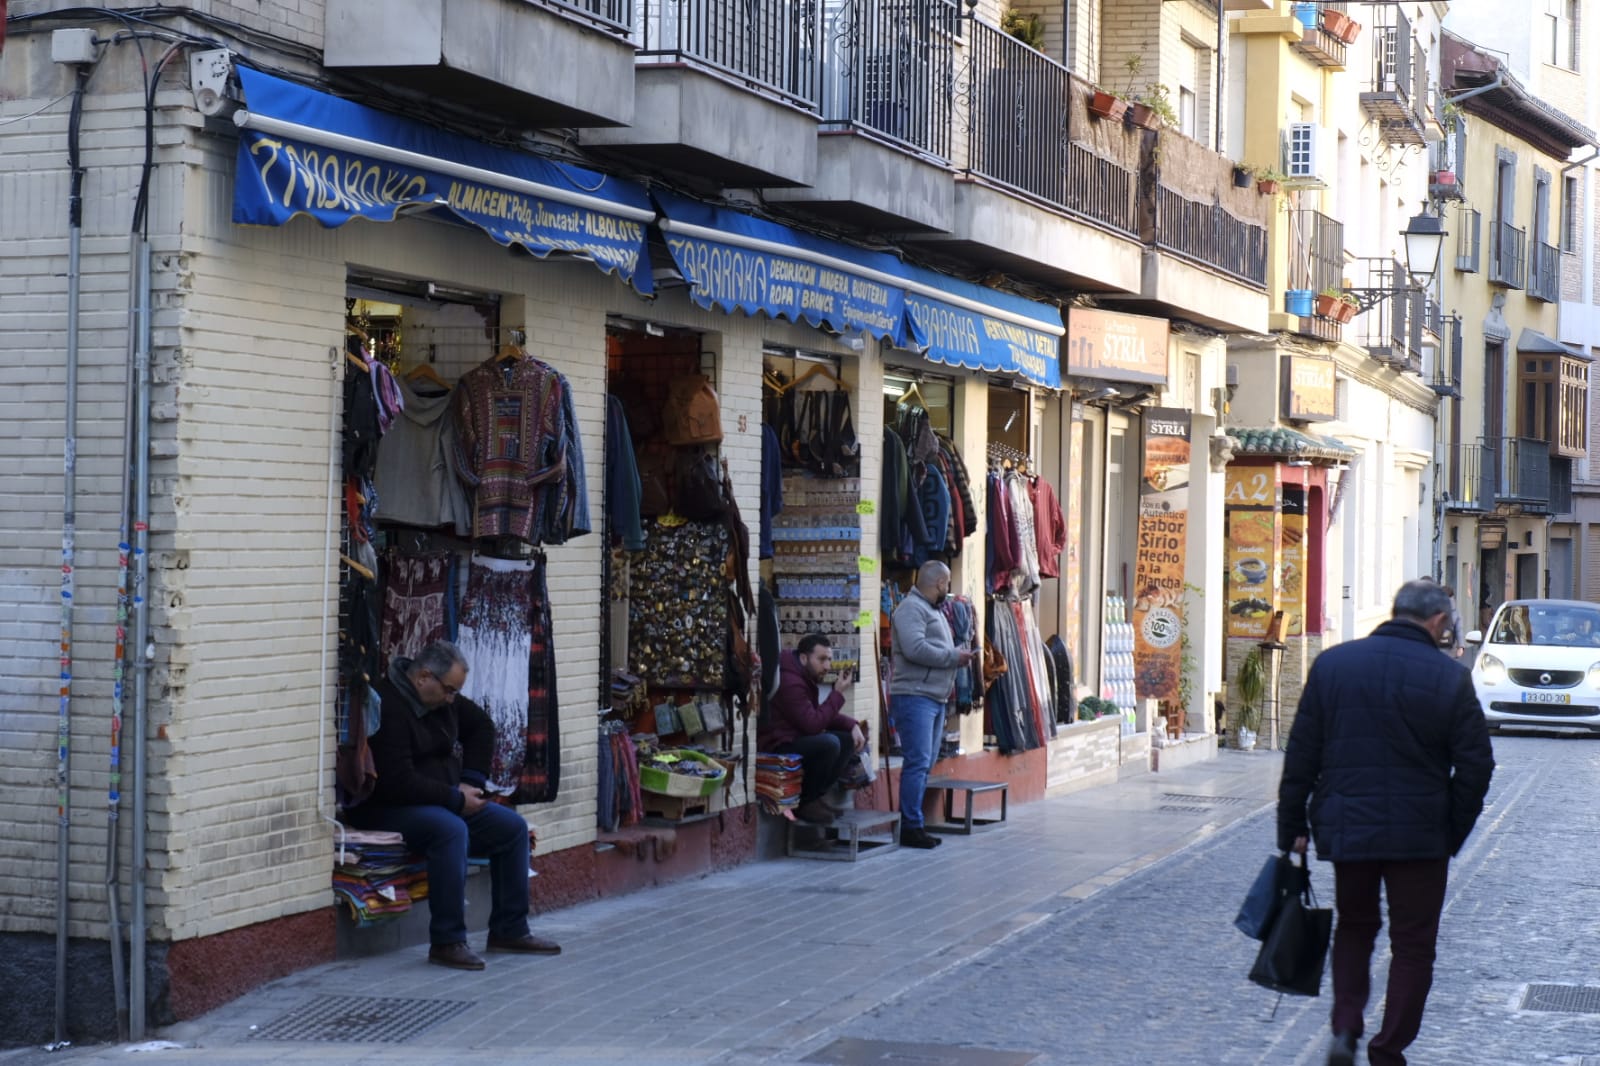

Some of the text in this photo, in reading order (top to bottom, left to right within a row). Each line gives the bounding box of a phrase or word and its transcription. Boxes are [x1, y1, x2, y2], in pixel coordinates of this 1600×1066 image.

[1103, 333, 1148, 364] SYRIA
[1150, 423, 1186, 436] SYRIA
[1141, 519, 1185, 533] sabor
[1140, 533, 1179, 550] Sirio
[1138, 549, 1180, 564] Hecho
[1137, 563, 1161, 574] a la
[1137, 573, 1181, 590] Plancha
